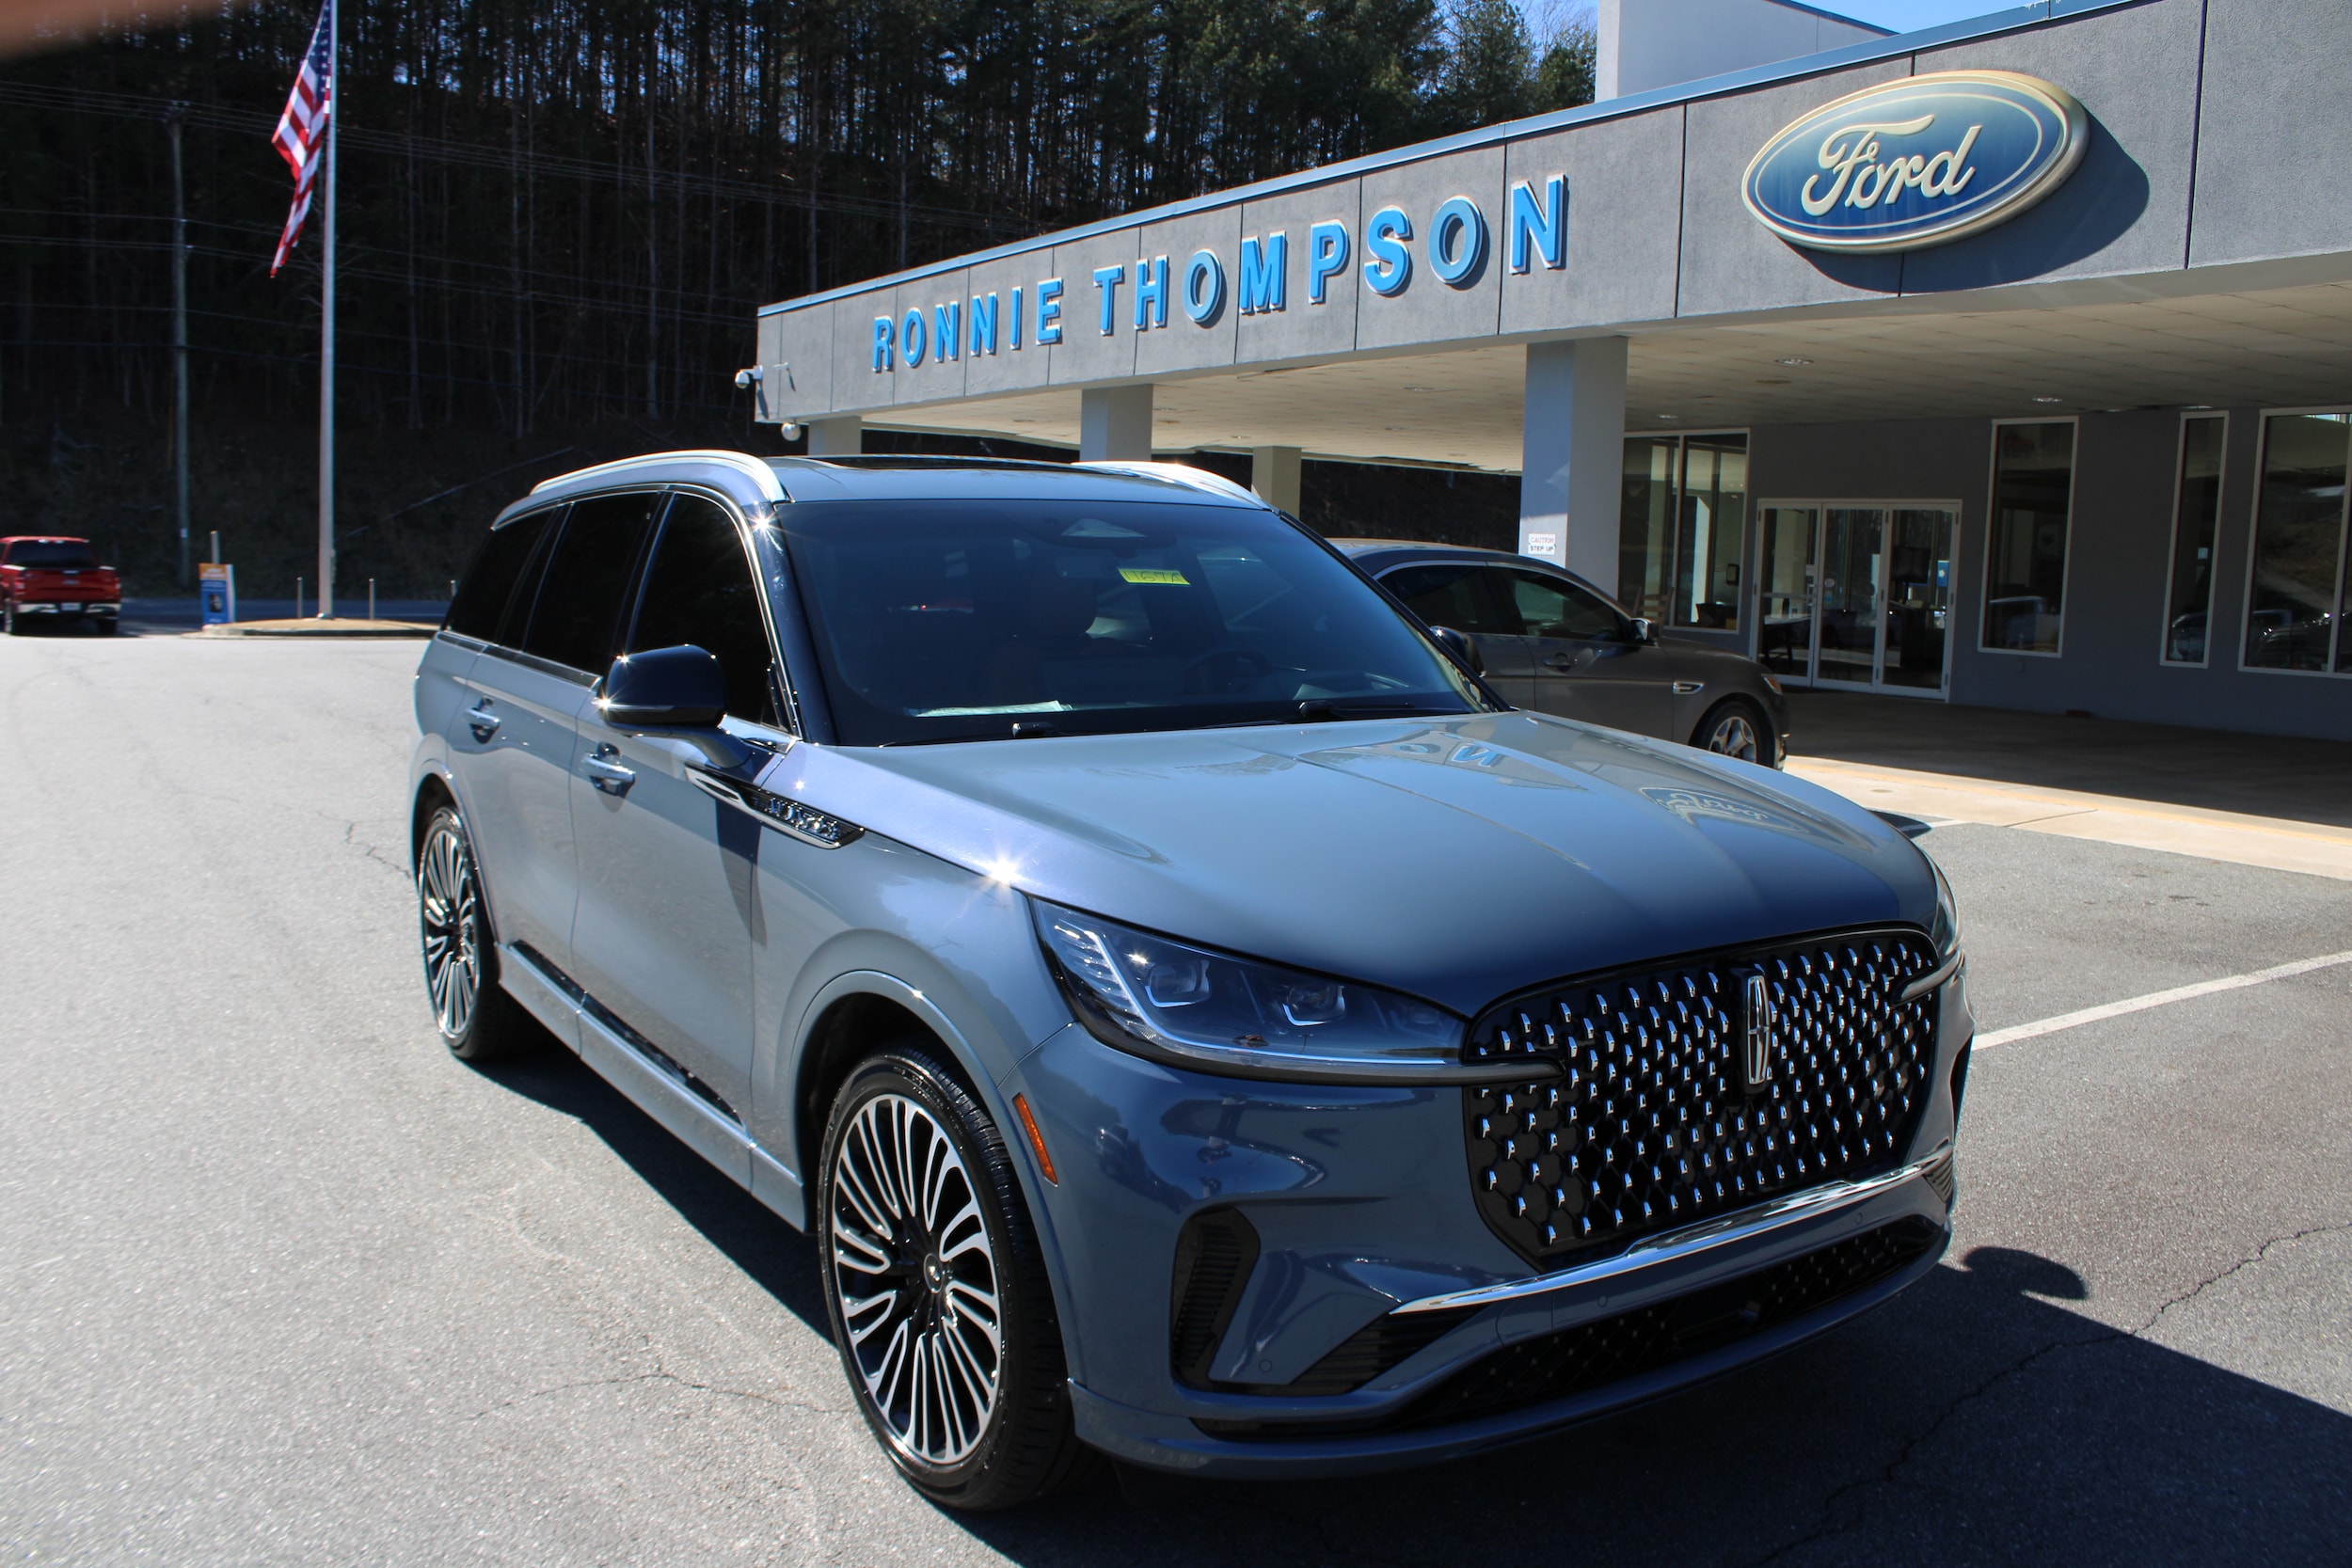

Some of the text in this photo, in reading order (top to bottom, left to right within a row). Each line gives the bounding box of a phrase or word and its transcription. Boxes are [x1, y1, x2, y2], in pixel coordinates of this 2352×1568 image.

[1801, 114, 1982, 217] Ford
[872, 173, 1567, 373] RONNIE THOMPSON
